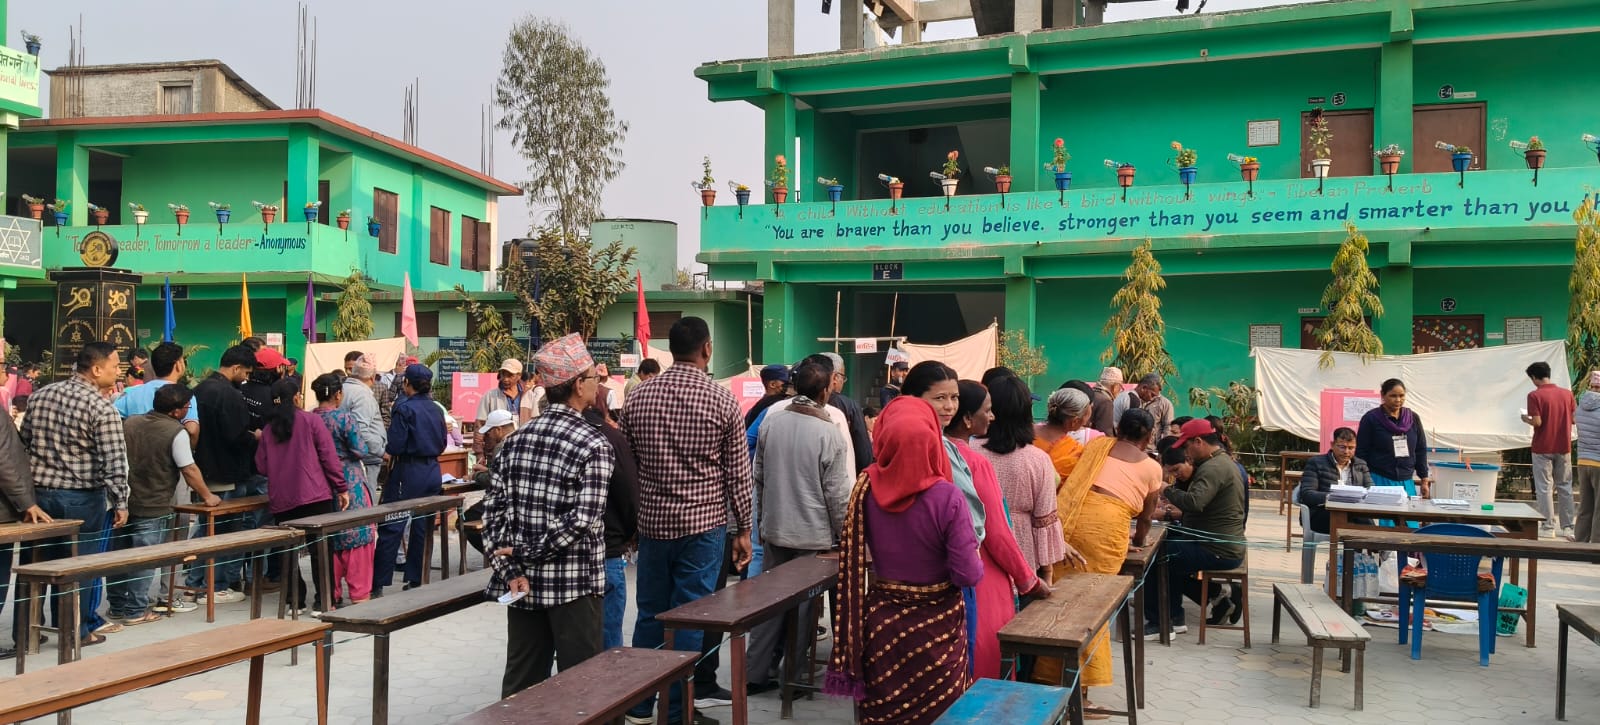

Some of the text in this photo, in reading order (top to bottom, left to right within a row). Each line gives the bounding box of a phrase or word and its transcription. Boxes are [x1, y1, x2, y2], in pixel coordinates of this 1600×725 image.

[918, 198, 1001, 216] education
[1007, 198, 1020, 212] is
[1027, 196, 1053, 211] like
[1062, 200, 1070, 209] a
[1081, 193, 1116, 209] bird
[1128, 189, 1196, 206] without
[1286, 182, 1348, 199] Tibetan
[1354, 178, 1432, 198] Proverb
[801, 227, 824, 239] are
[836, 222, 886, 238] braver
[892, 218, 932, 237] than
[940, 222, 972, 241] you
[982, 215, 1044, 234] believe.
[1058, 212, 1140, 235] stronger
[1149, 209, 1194, 227] than
[1201, 211, 1239, 232] you
[1251, 209, 1303, 224] seem
[1310, 202, 1349, 221] and
[1358, 199, 1453, 220] smarter
[1463, 197, 1519, 216] than
[1524, 200, 1570, 222] you
[118, 236, 152, 253] eader,
[154, 234, 200, 251] Tomorrow
[204, 239, 211, 250] a
[882, 270, 891, 279] E
